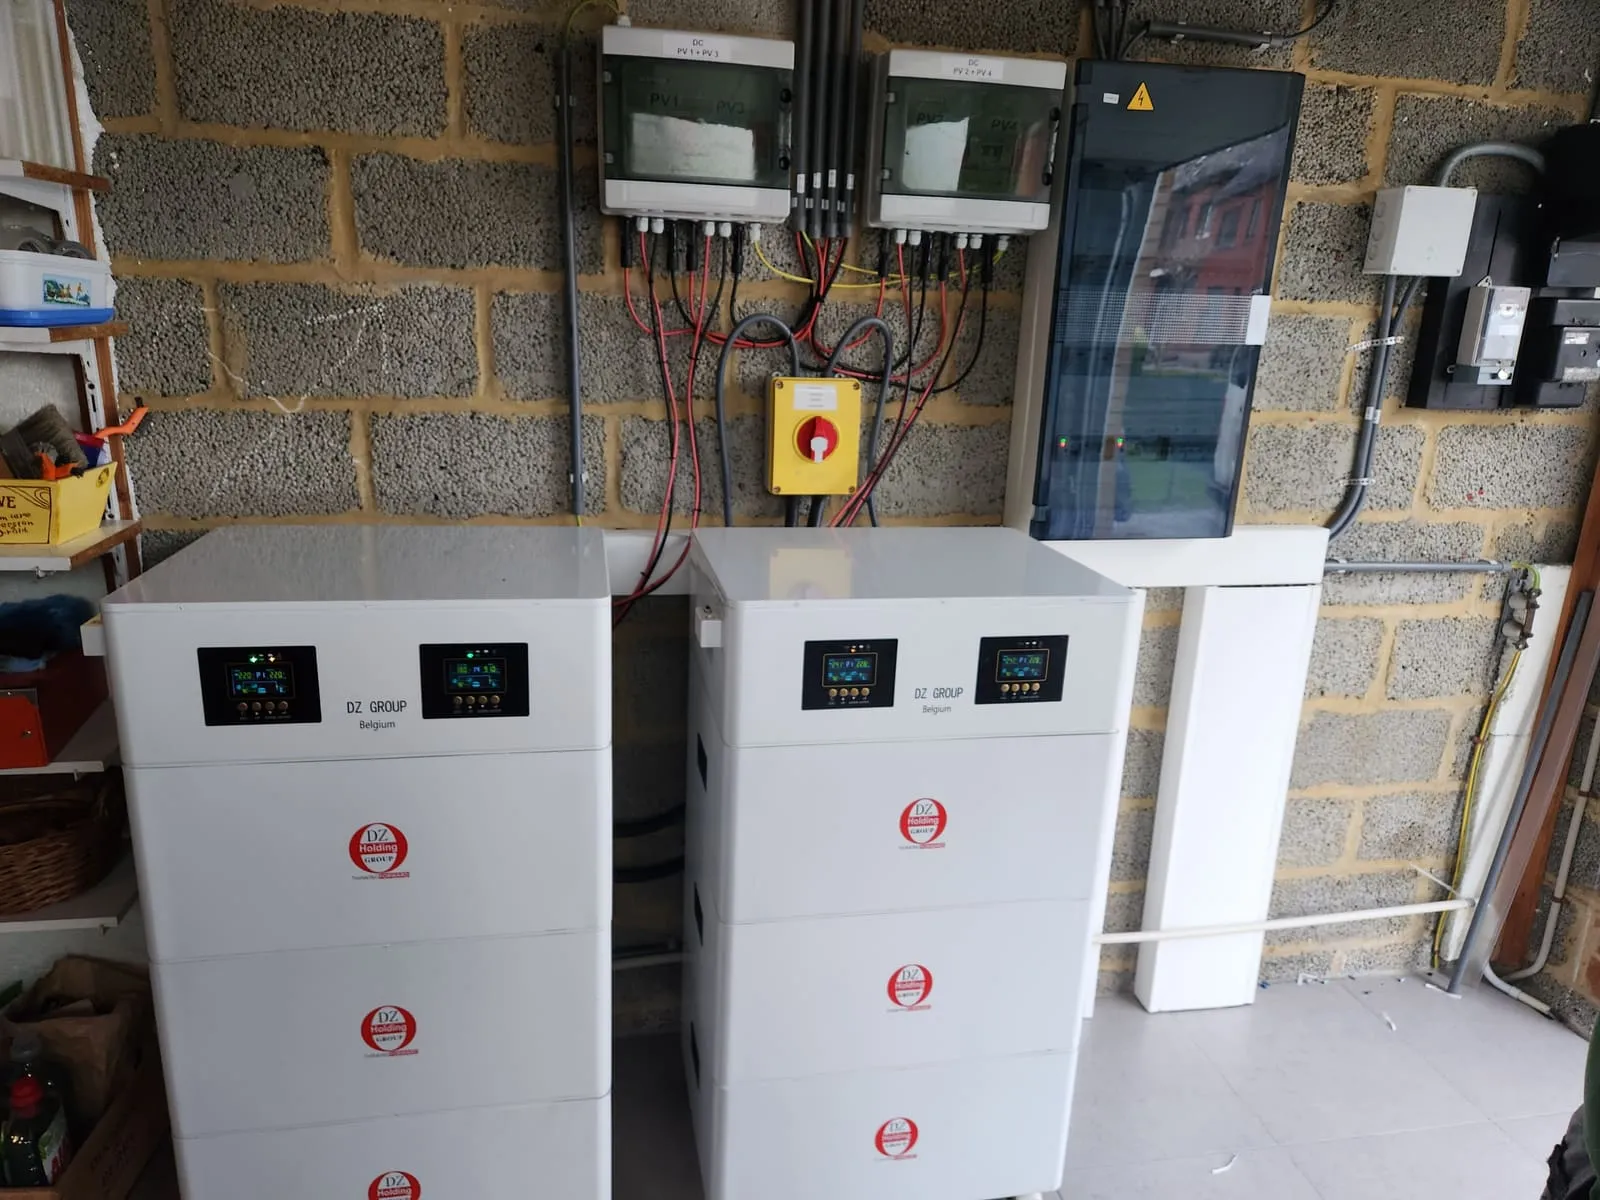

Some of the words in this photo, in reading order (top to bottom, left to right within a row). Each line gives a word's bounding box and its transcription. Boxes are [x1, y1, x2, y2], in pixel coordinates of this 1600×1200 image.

[692, 38, 704, 47] DC
[677, 47, 688, 55] PV
[702, 48, 712, 57] PV
[968, 58, 979, 67] DC
[953, 67, 963, 75] PV
[976, 68, 987, 76] PV
[650, 92, 679, 108] PV1
[914, 687, 927, 699] DZ
[932, 687, 964, 699] GROUP
[347, 701, 363, 714] DZ
[369, 700, 408, 713] GROUP
[922, 704, 952, 715] Belgium
[359, 719, 396, 732] Belgium
[915, 803, 933, 815] DZ
[908, 816, 939, 826] Holding
[367, 828, 388, 842] DZ
[910, 827, 934, 835] GROUP
[359, 843, 398, 854] Holding
[364, 855, 394, 864] GROUP
[902, 968, 919, 980] DZ
[378, 1010, 399, 1023] DZ
[370, 1023, 407, 1034] Holding
[385, 1175, 406, 1187] DZ
[377, 1188, 412, 1198] Holding
